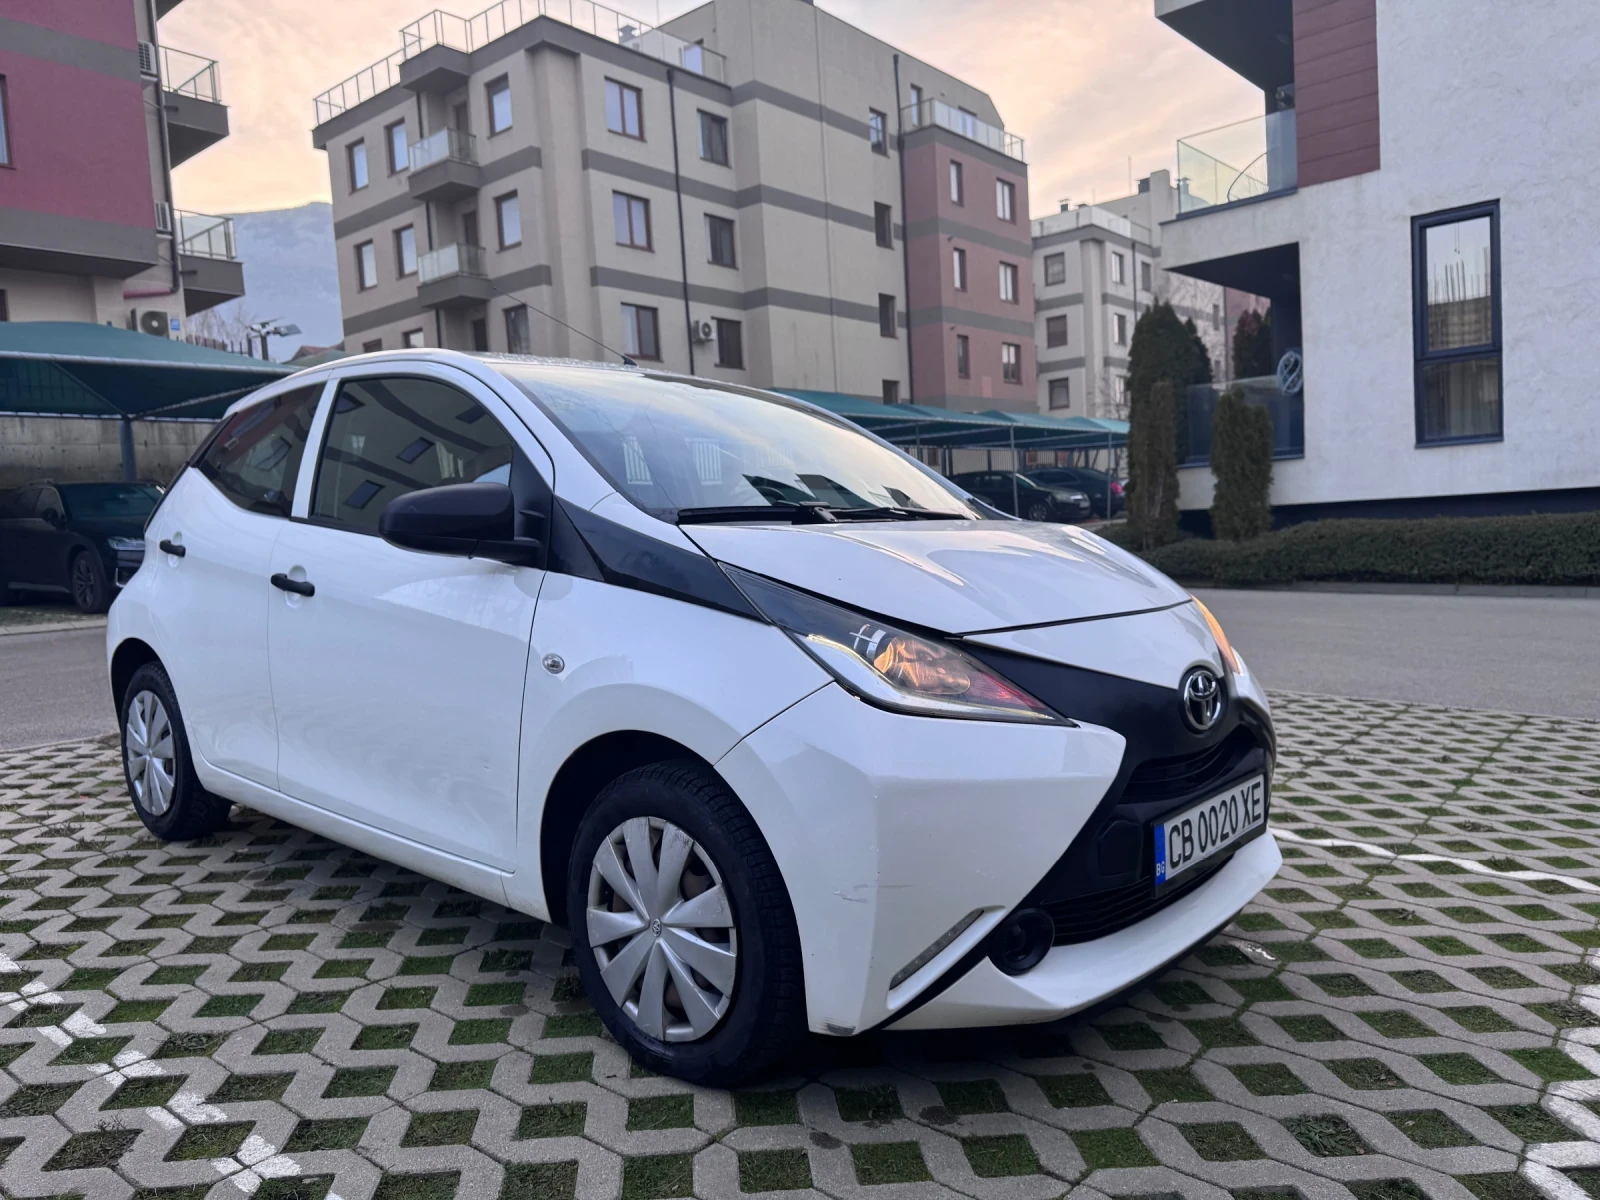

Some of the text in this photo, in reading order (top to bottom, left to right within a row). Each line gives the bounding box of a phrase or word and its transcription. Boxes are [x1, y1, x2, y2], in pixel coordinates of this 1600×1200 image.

[1169, 781, 1261, 869] CB 0020 XE
[1156, 861, 1165, 876] BG
